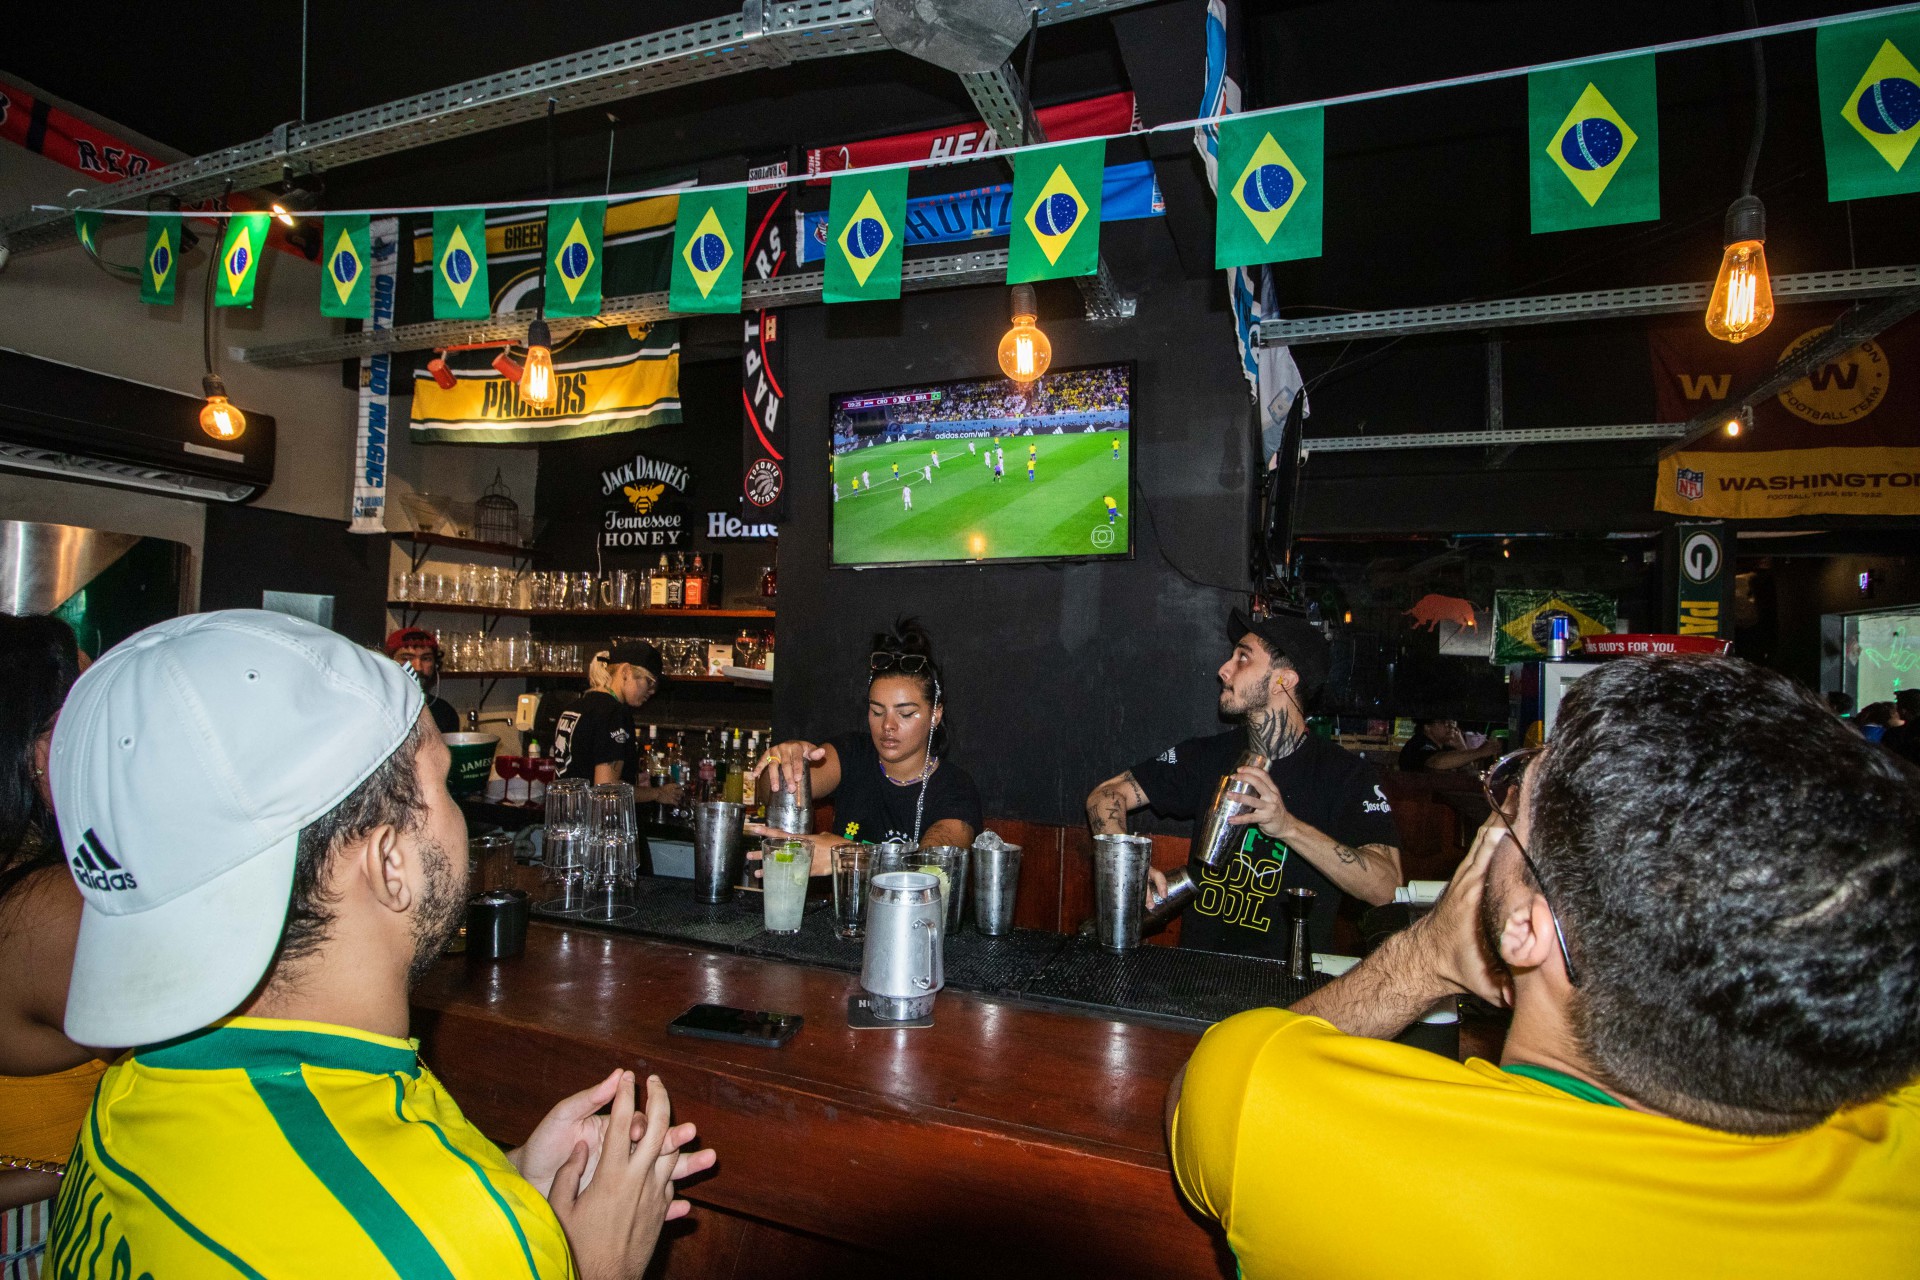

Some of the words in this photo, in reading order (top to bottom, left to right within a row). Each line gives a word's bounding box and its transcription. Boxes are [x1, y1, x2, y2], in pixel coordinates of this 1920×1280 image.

[1677, 374, 1732, 400] W
[1783, 390, 1848, 420] FOOTBALL
[1849, 386, 1881, 415] TEAM
[365, 401, 388, 488] MAGIC
[935, 429, 990, 440] adidas.com/win
[602, 462, 635, 496] JACK
[636, 454, 690, 492] DANIEL'S
[749, 461, 779, 480] TORONTO
[1678, 478, 1701, 498] NFL
[604, 510, 682, 530] Tennessee
[604, 530, 682, 546] HONEY
[1599, 642, 1625, 652] BUD'S
[1628, 641, 1649, 652] FOR
[1651, 642, 1677, 653] YOU.
[74, 867, 138, 892] adidas
